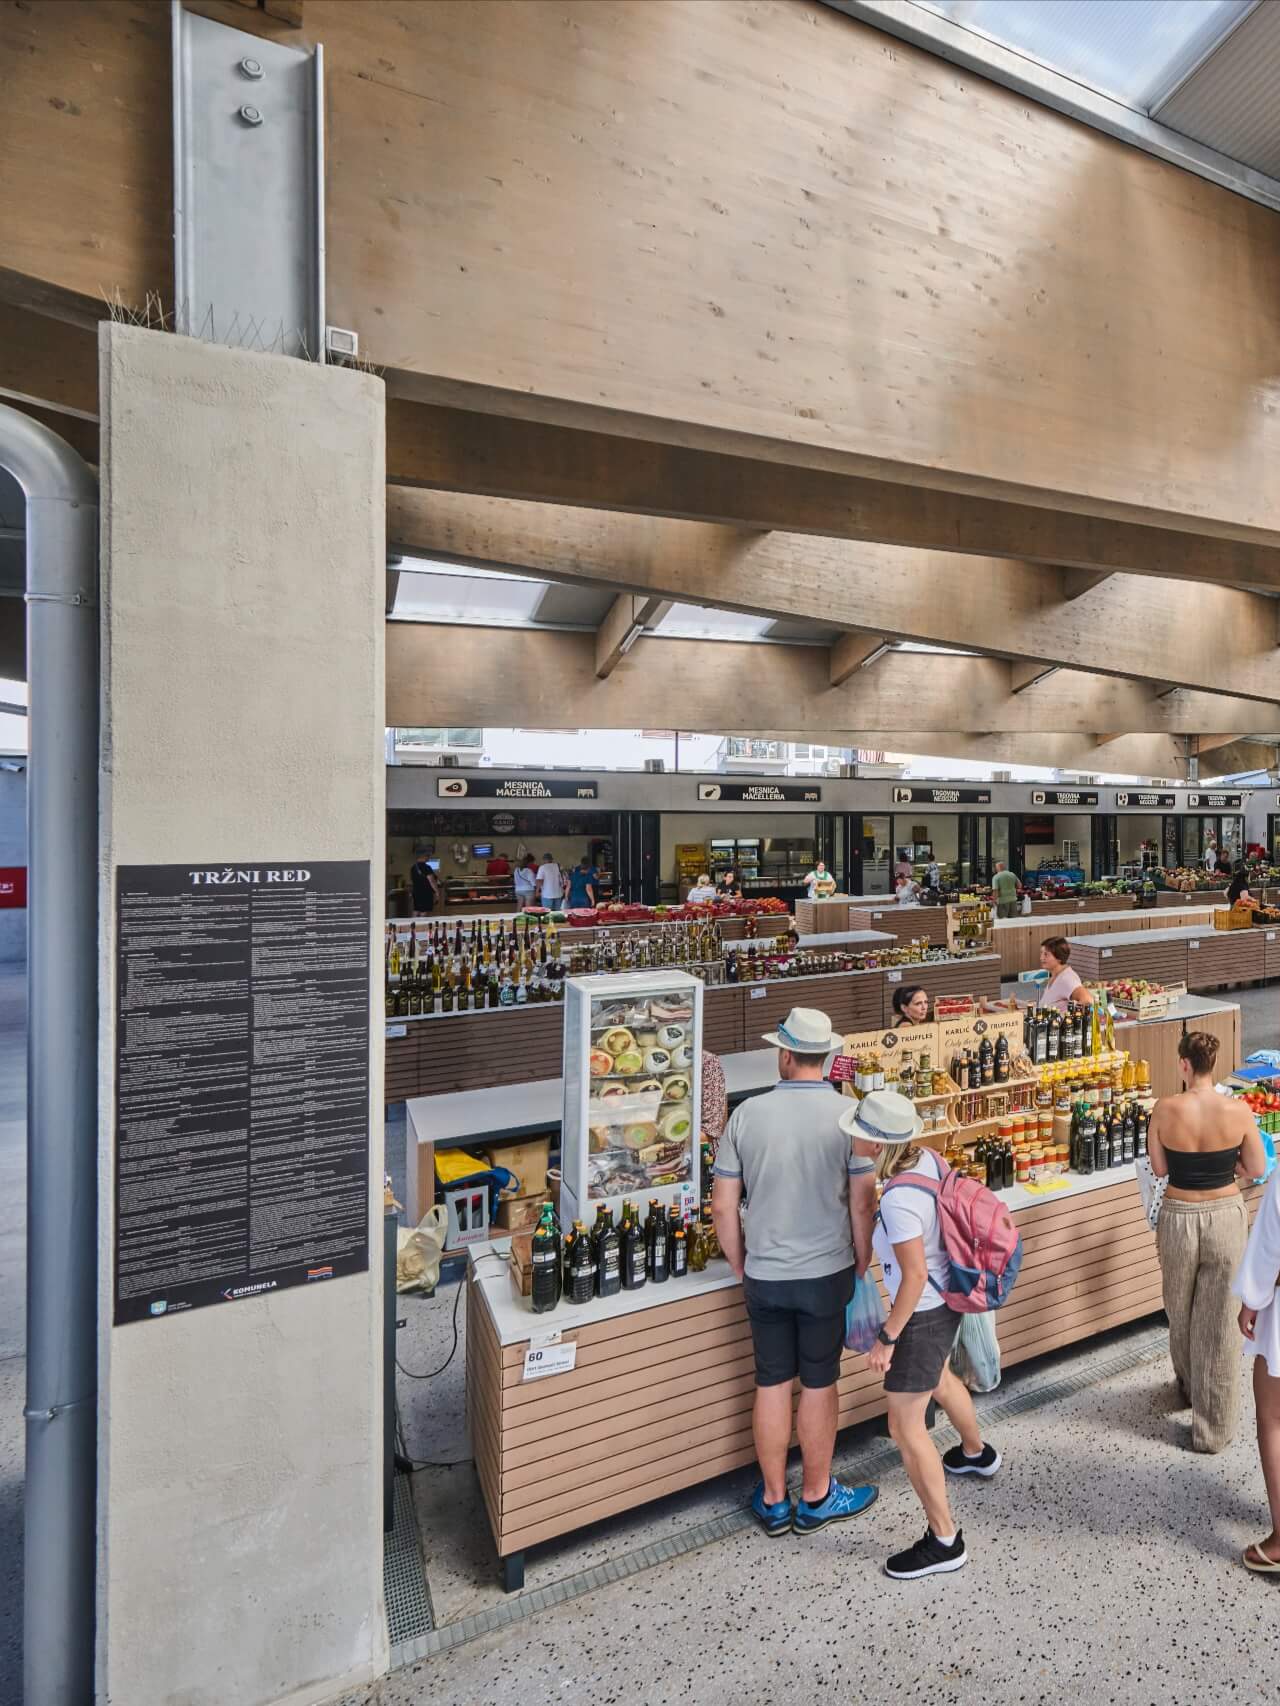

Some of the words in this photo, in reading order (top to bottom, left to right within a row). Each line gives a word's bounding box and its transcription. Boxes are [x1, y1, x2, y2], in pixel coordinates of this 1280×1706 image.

[504, 781, 544, 790] MESNICA
[748, 786, 779, 794] MESNICA
[496, 788, 552, 797] MACELLERIA
[188, 867, 261, 884] TRŽNI
[265, 869, 311, 882] RED
[901, 1032, 933, 1042] TRUFFLES
[528, 1351, 543, 1362] 60
